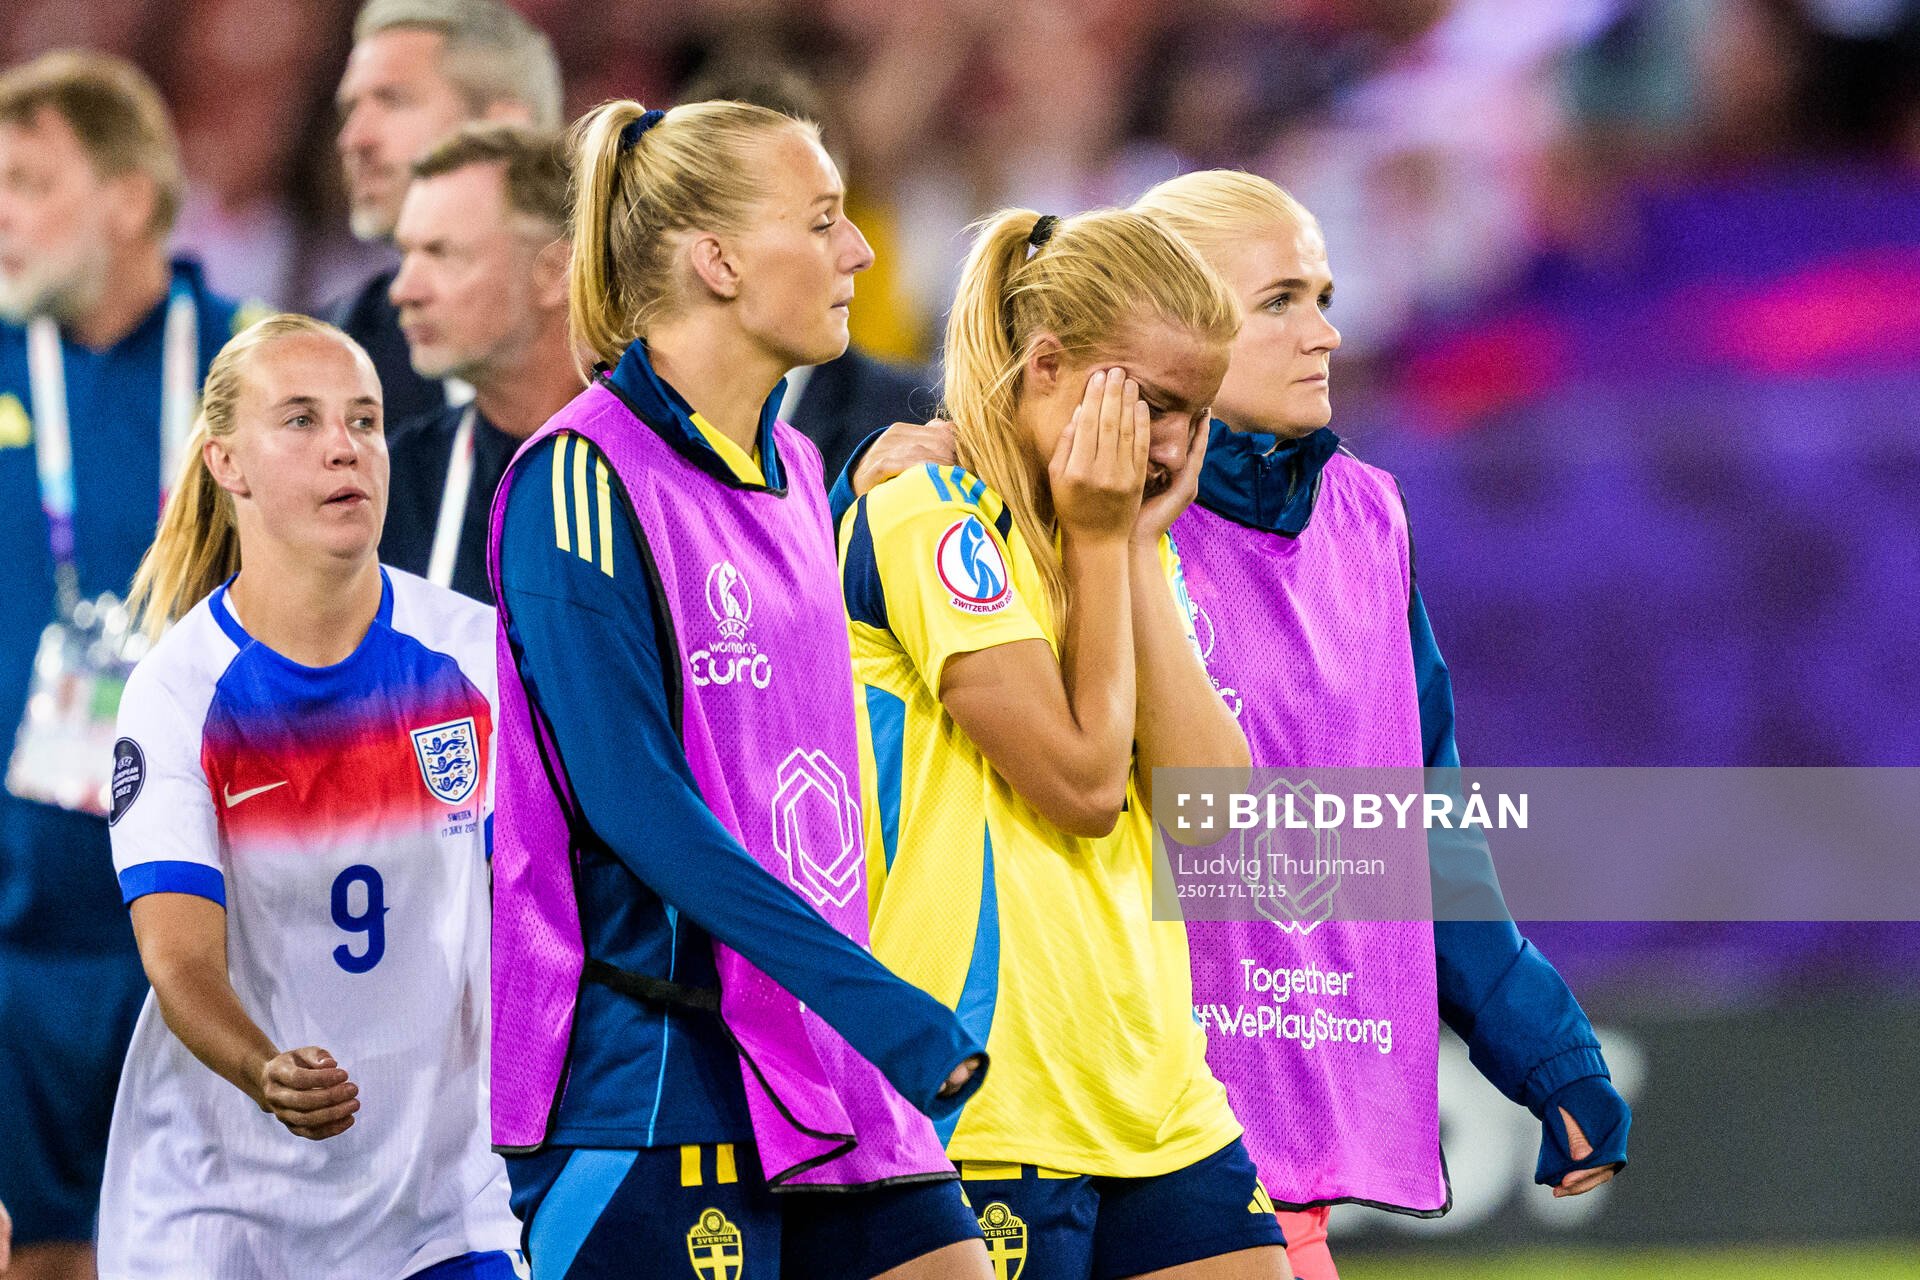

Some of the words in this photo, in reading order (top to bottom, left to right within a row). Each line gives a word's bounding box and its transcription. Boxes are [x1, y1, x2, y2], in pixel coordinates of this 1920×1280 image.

[952, 597, 1005, 613] SWITZERLAND
[718, 623, 746, 640] UEFA
[113, 766, 139, 783] UROPEAN
[447, 810, 472, 822] SWEDEN
[331, 864, 388, 974] 9
[1240, 959, 1354, 1003] Together
[1193, 1004, 1393, 1054] #WePlayStrong
[697, 1235, 734, 1246] SVERIGE
[983, 1228, 1018, 1238] VERIGE
